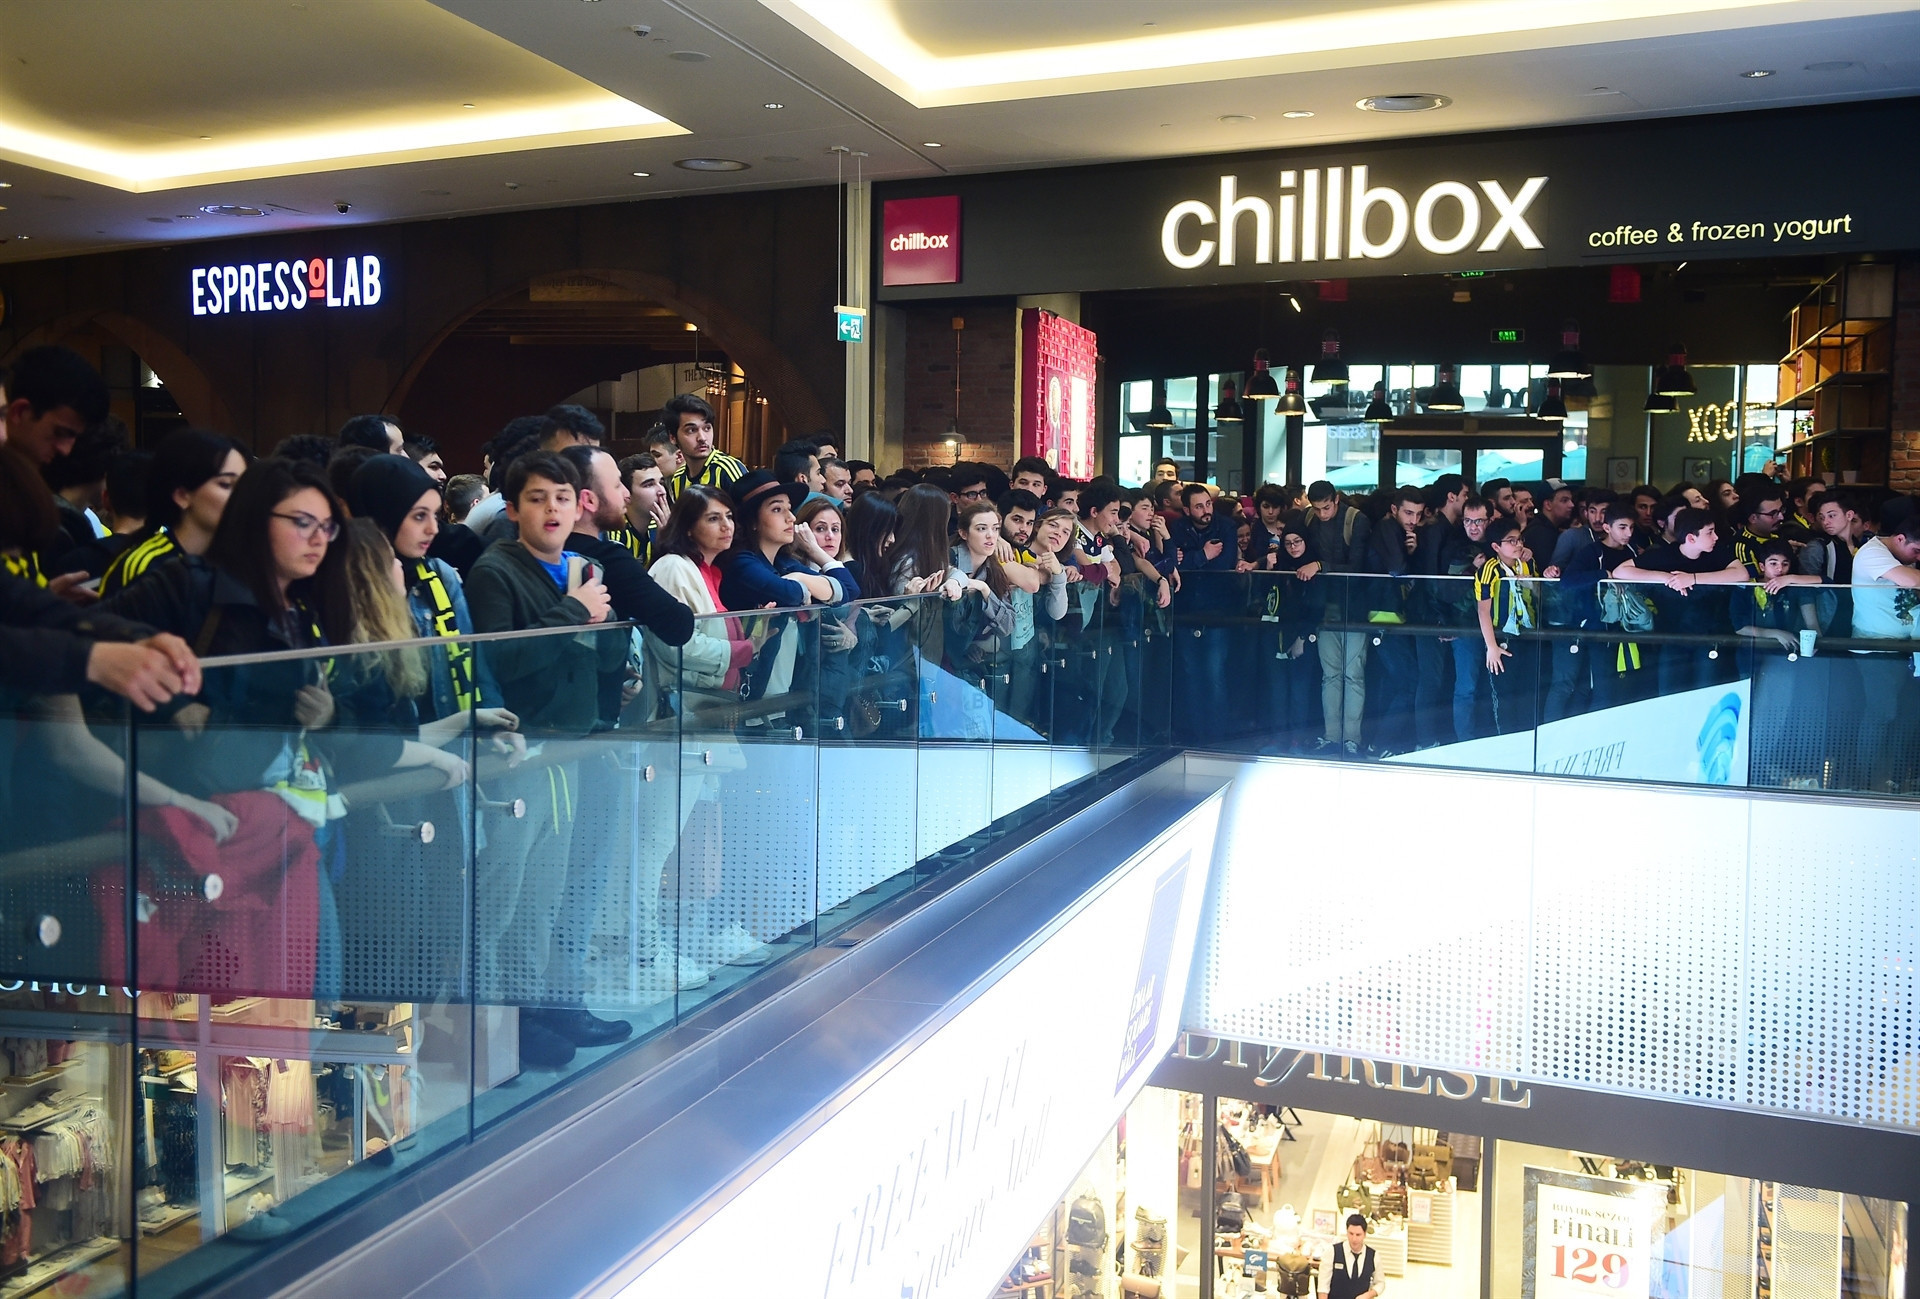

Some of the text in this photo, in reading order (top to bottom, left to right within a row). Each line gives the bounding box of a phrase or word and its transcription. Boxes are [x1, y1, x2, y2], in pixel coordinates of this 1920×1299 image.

[1161, 165, 1549, 270] chillbox
[1588, 214, 1852, 247] coffee & frozen yogurt
[890, 232, 949, 251] chillbox
[1551, 1245, 1629, 1289] 129
